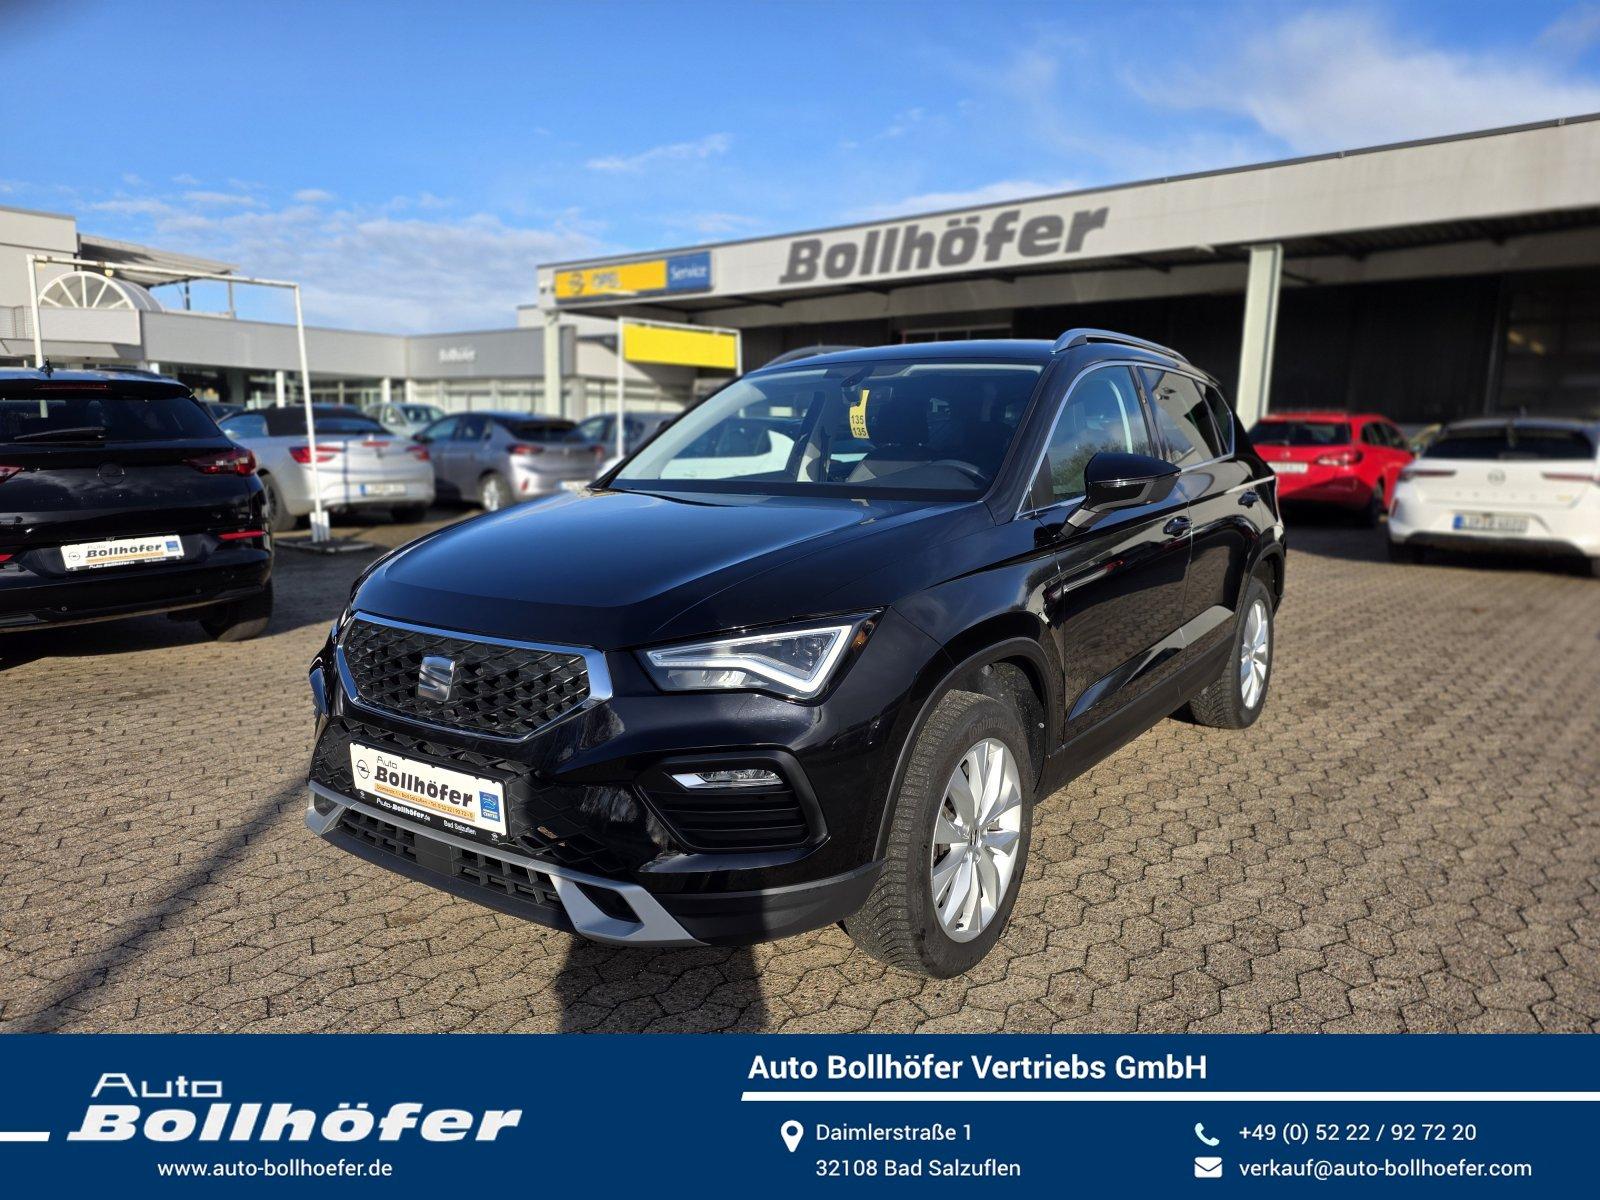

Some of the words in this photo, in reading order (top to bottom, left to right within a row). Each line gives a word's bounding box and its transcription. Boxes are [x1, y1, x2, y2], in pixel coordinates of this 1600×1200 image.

[779, 207, 1109, 284] Bollhöfer
[669, 263, 707, 281] Service
[851, 415, 865, 425] 135
[853, 427, 867, 437] 135
[376, 755, 398, 770] Auto
[374, 765, 474, 808] Bollhöfer
